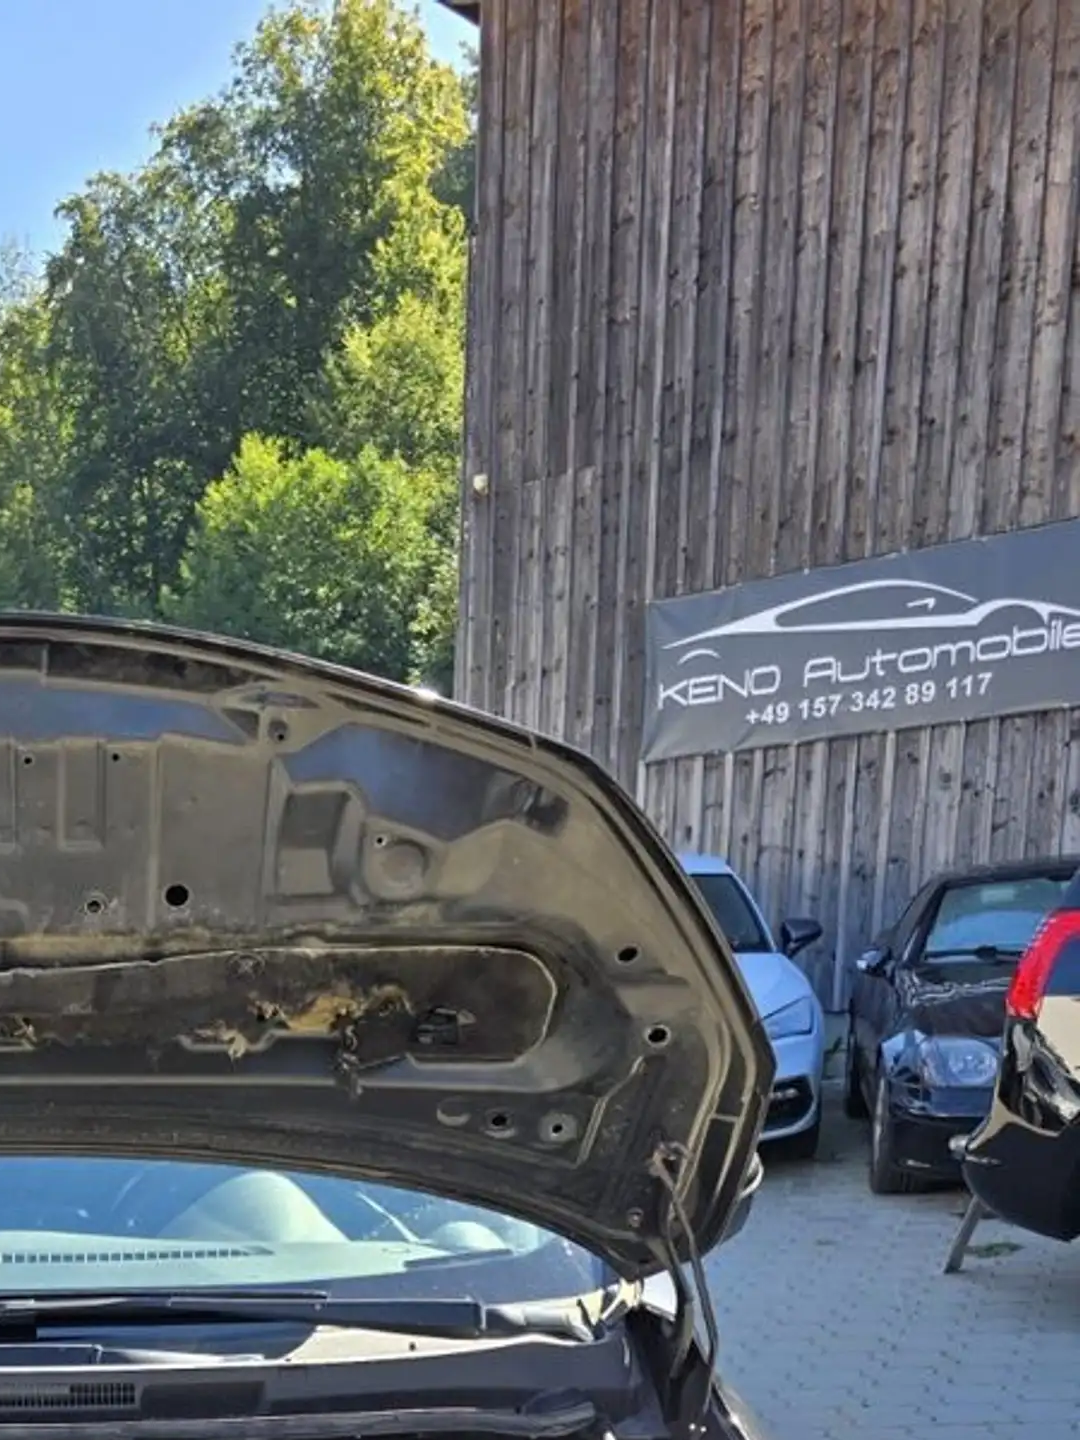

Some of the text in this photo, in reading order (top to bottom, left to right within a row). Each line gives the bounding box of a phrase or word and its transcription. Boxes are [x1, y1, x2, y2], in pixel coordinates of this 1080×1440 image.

[657, 664, 781, 709] KENO
[745, 672, 993, 726] +49 157 342 89 117
